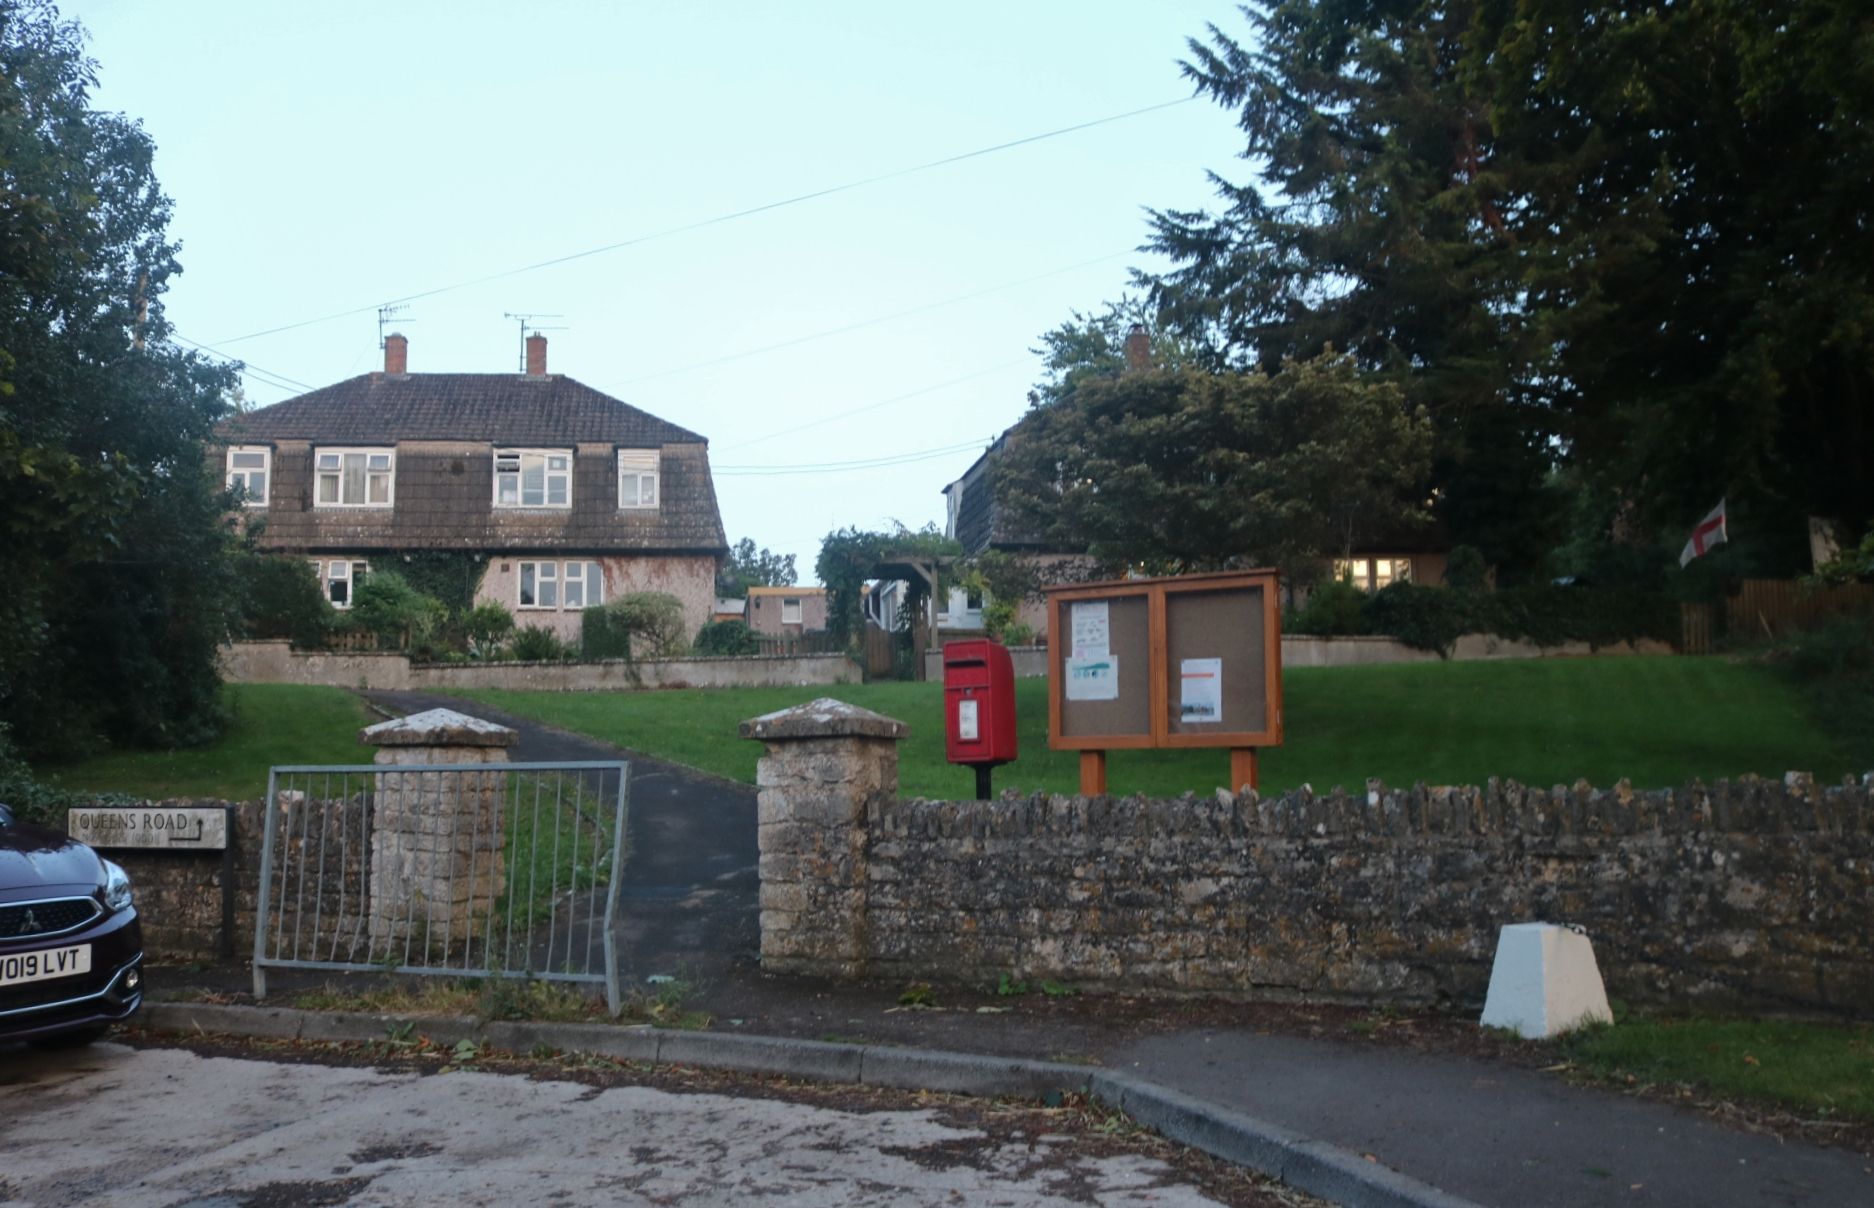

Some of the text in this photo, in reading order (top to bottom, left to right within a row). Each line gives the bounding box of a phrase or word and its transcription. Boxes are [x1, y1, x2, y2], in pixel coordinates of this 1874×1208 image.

[80, 813, 188, 830] QUEENS ROAD
[43, 948, 80, 975] LVT
